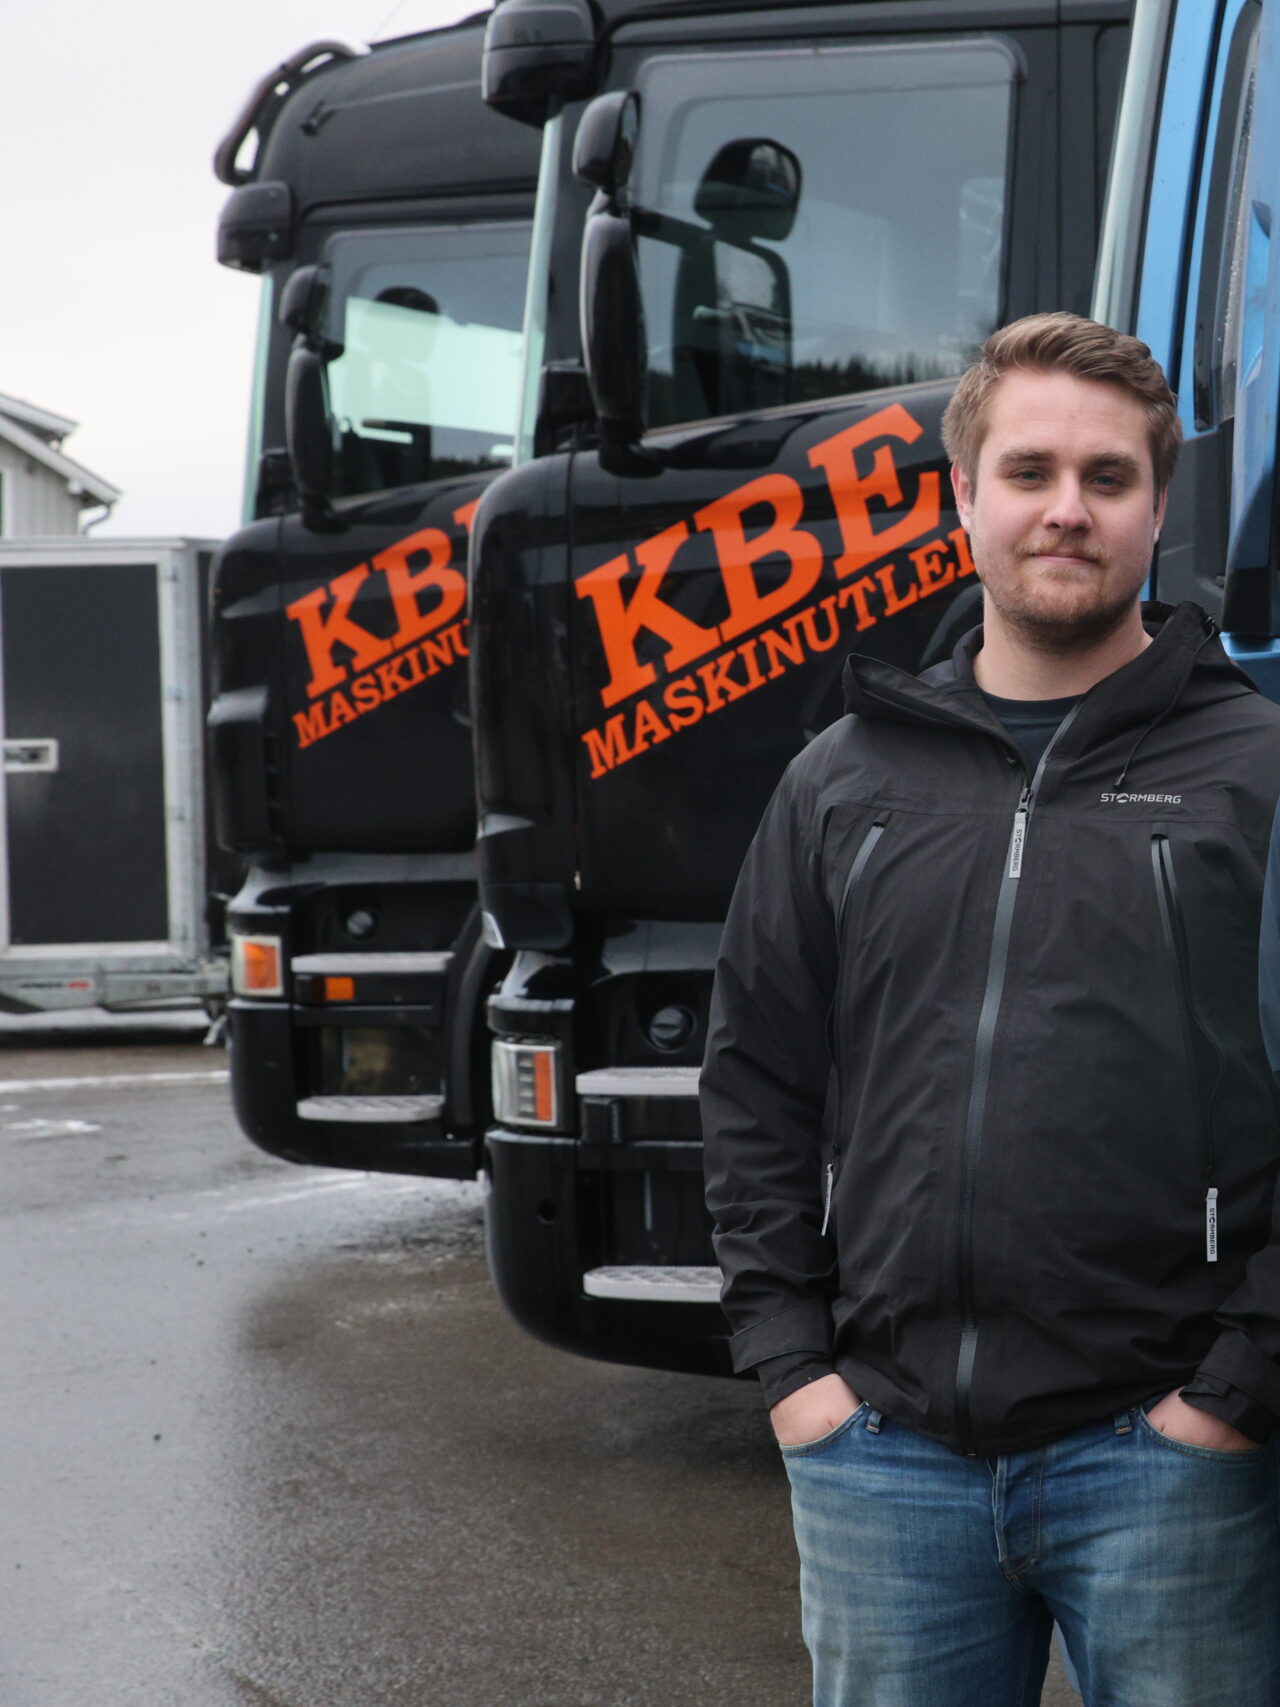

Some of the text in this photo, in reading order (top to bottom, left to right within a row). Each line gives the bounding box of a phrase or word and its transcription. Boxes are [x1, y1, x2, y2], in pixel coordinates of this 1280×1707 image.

[285, 498, 480, 700] KB
[575, 403, 941, 709] KBE
[1100, 792, 1182, 804] STORMBERG
